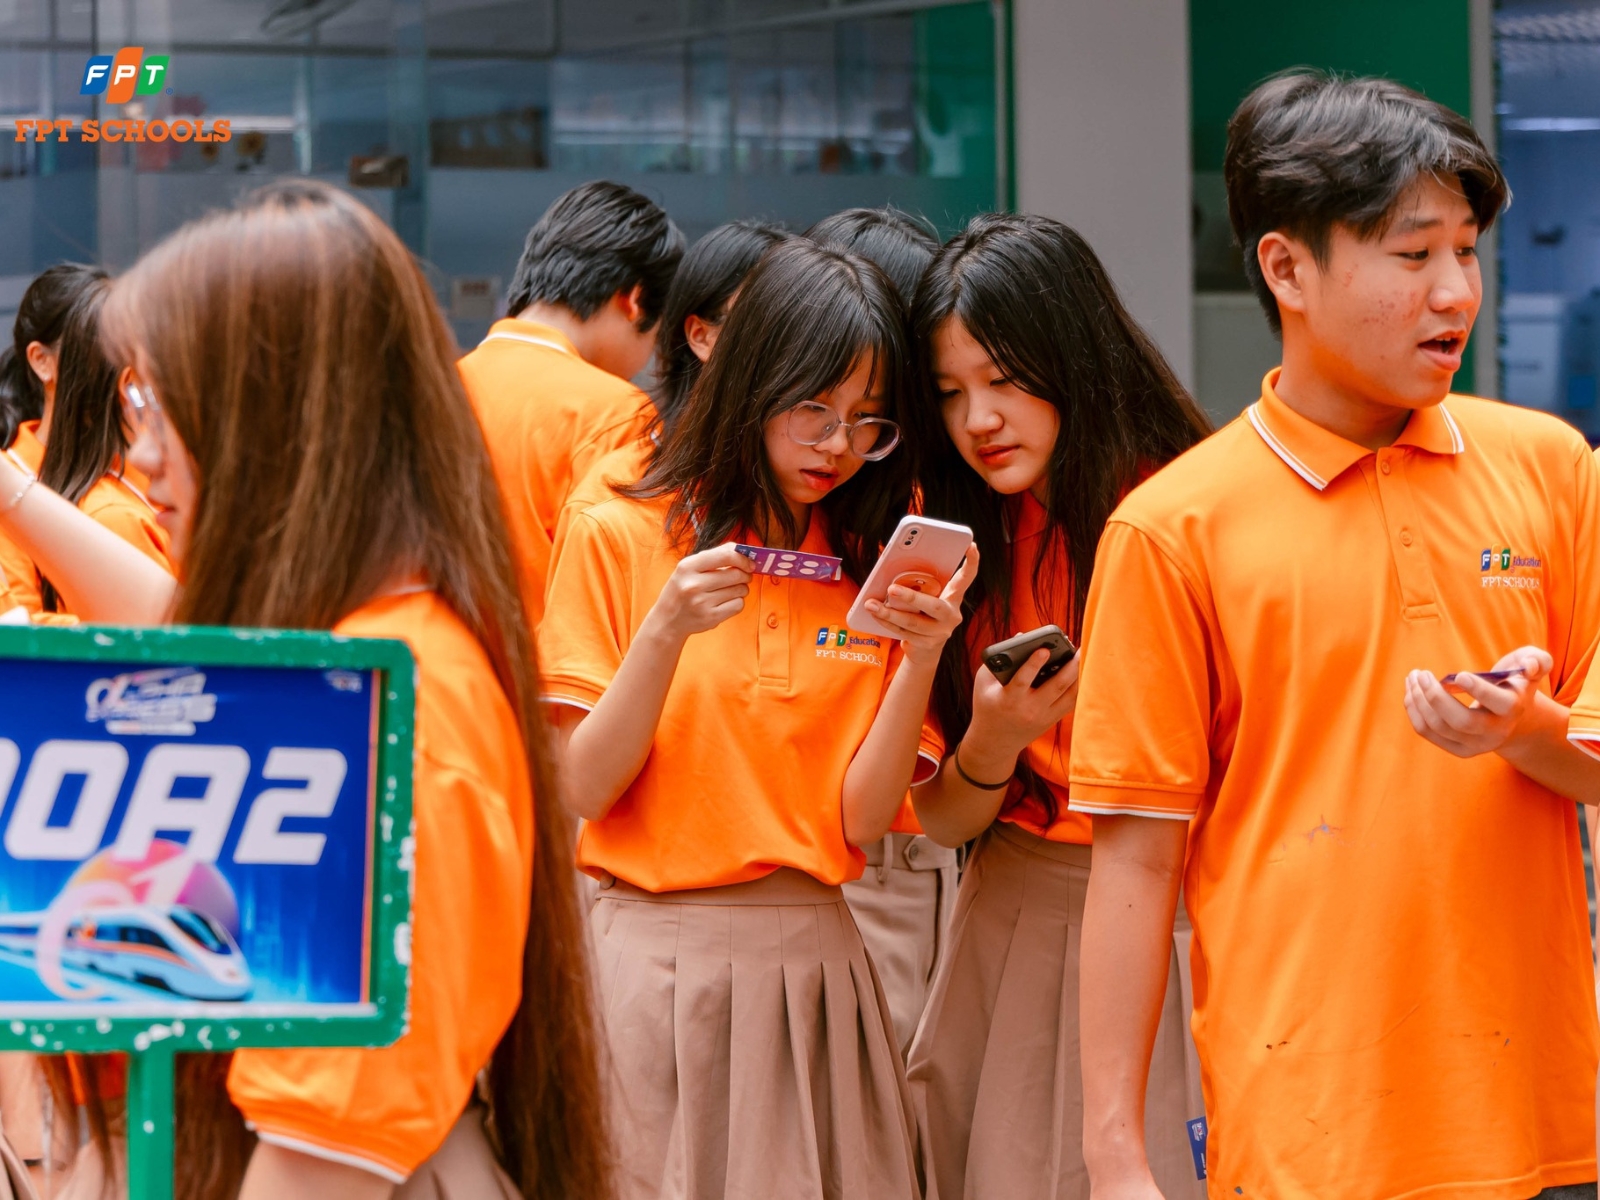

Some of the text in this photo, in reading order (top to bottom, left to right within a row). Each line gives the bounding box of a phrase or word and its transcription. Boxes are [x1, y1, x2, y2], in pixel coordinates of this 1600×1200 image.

[1482, 553, 1541, 567] FPT Education
[1481, 576, 1540, 589] FPT SCHOOLS
[818, 631, 881, 648] FPT Education
[815, 649, 882, 667] FPT SCHOOLS
[0, 737, 348, 866] 0A2
